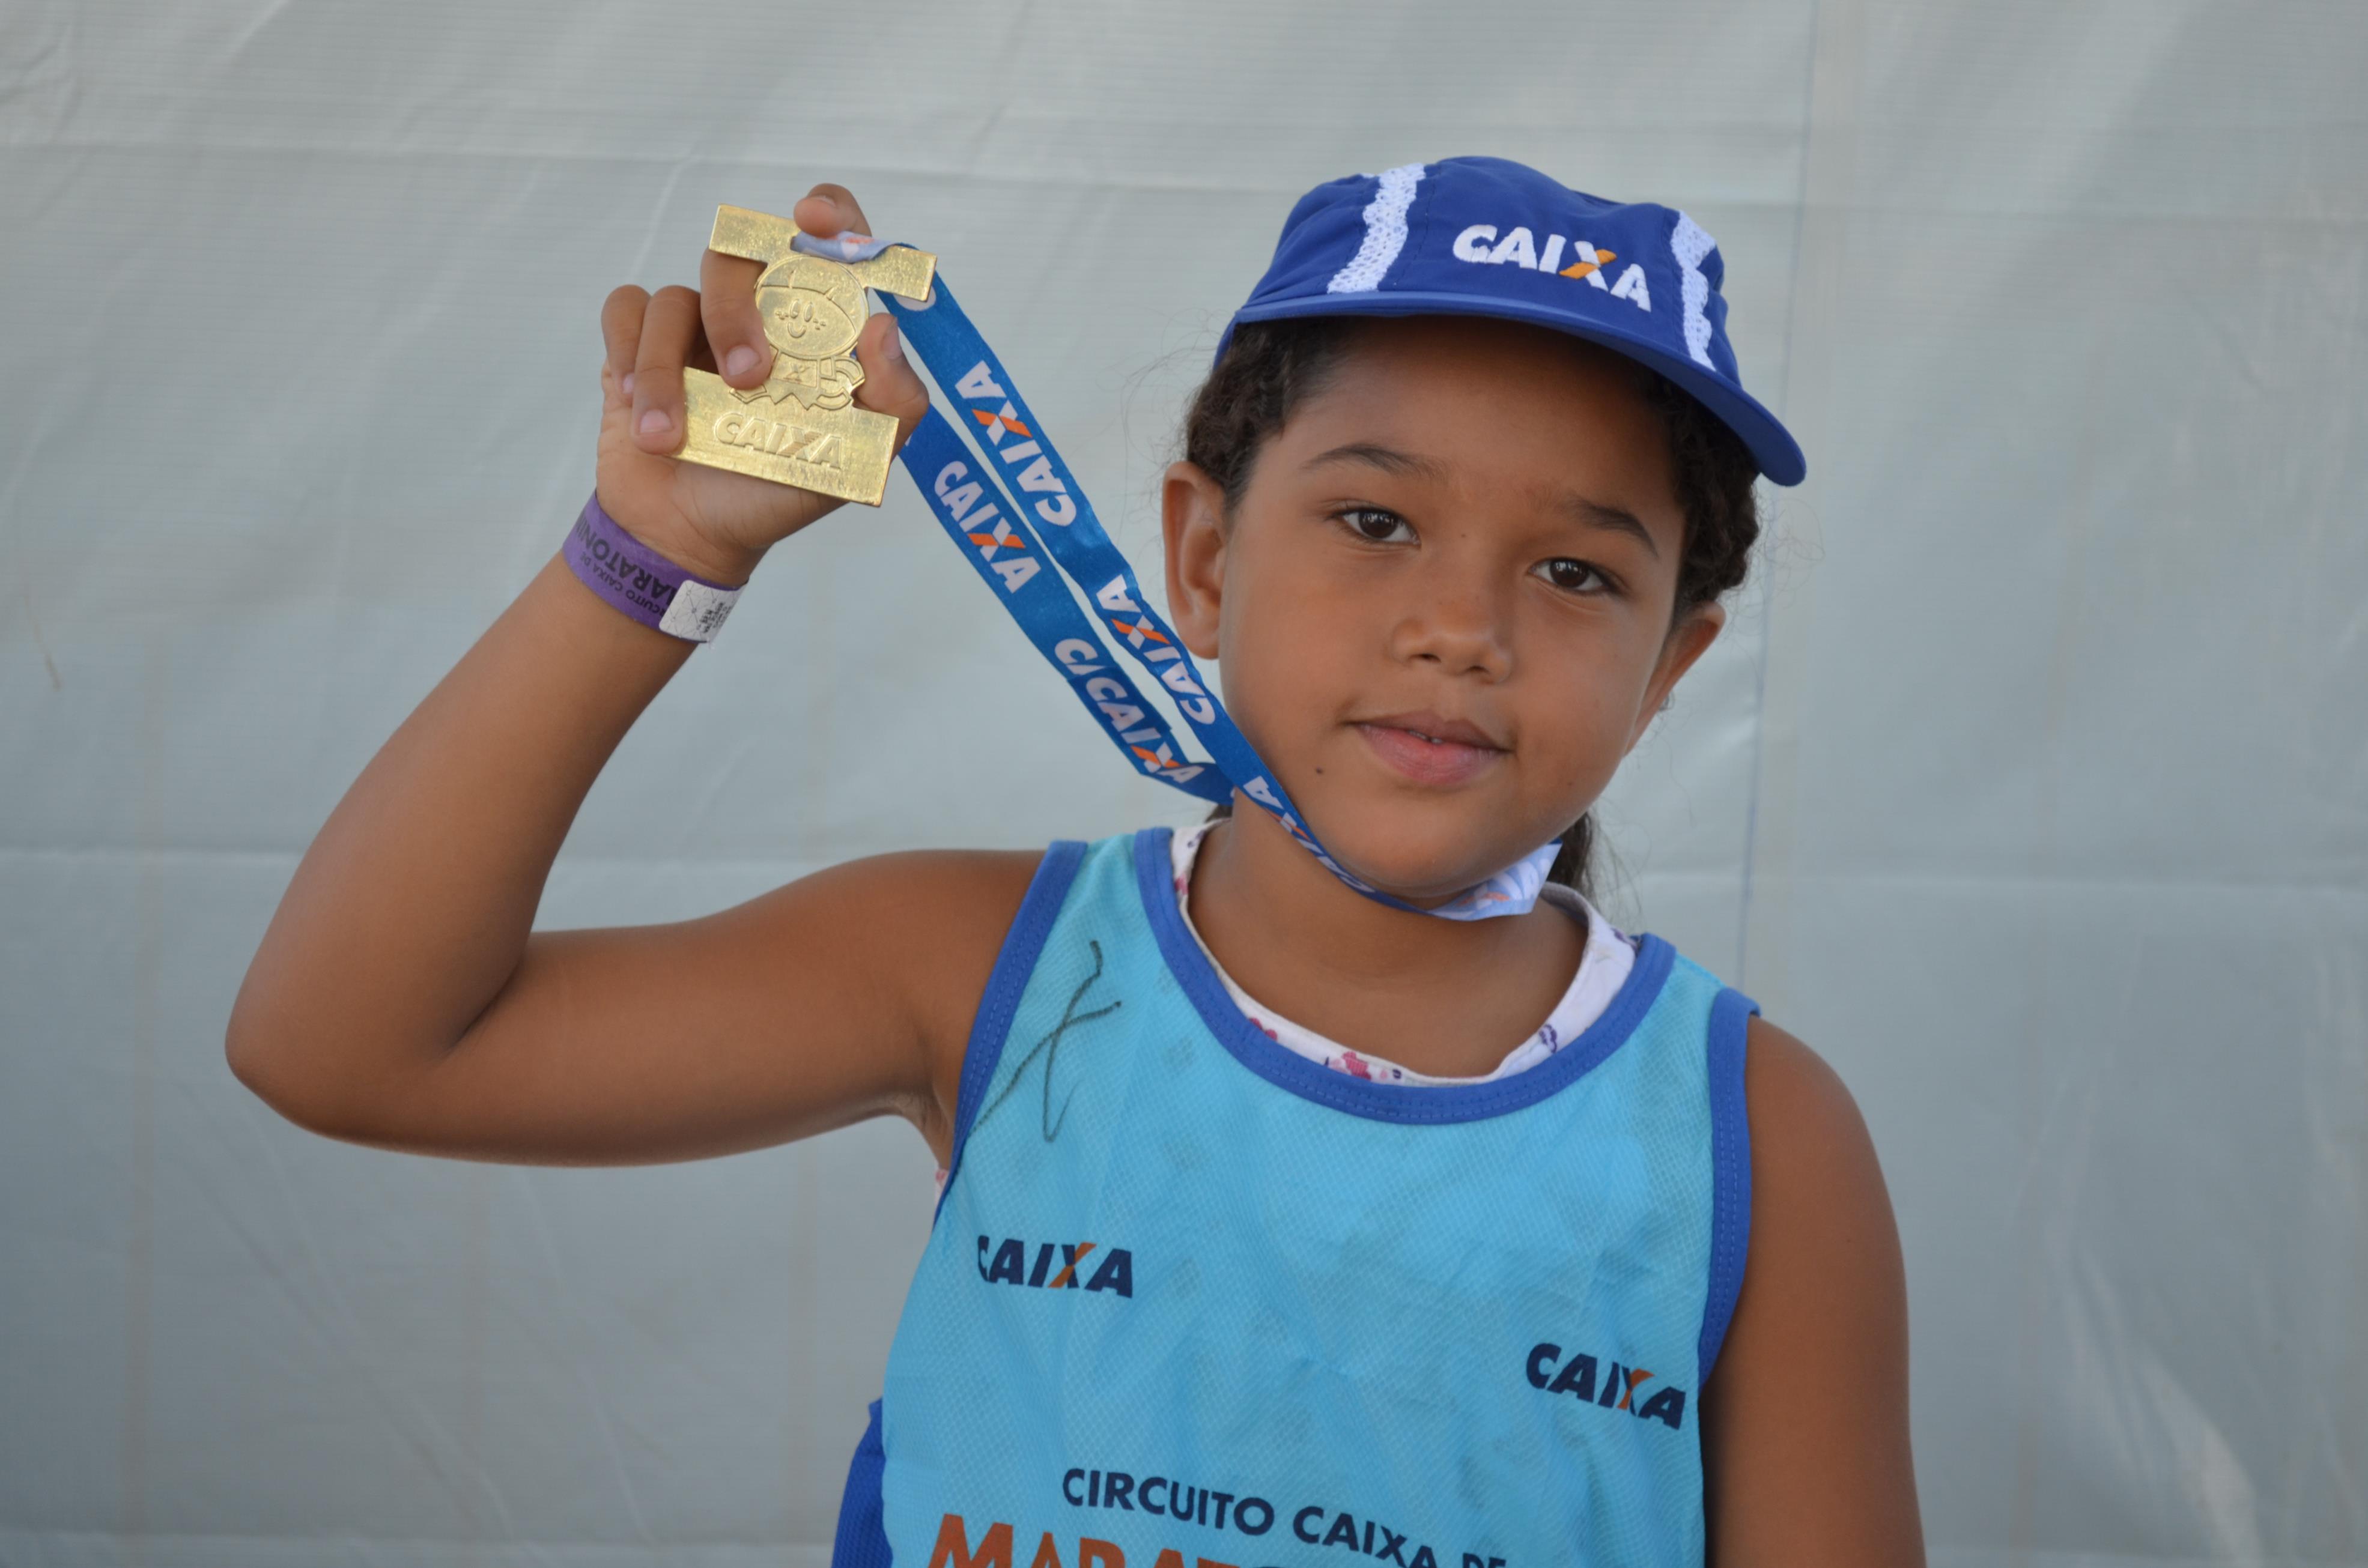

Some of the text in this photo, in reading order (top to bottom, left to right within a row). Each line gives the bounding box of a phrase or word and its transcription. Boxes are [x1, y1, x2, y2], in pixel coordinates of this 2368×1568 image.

[1453, 225, 1651, 312] CAIXA
[714, 412, 842, 470] CAIXA
[955, 360, 1077, 527] CAIXA
[934, 460, 1042, 594] CAIXA
[1096, 574, 1216, 725] CAIXA
[977, 1235, 1133, 1299] CAIXA
[1526, 1343, 1687, 1430] CAIXA
[1062, 1468, 1275, 1536] CIRCUITO
